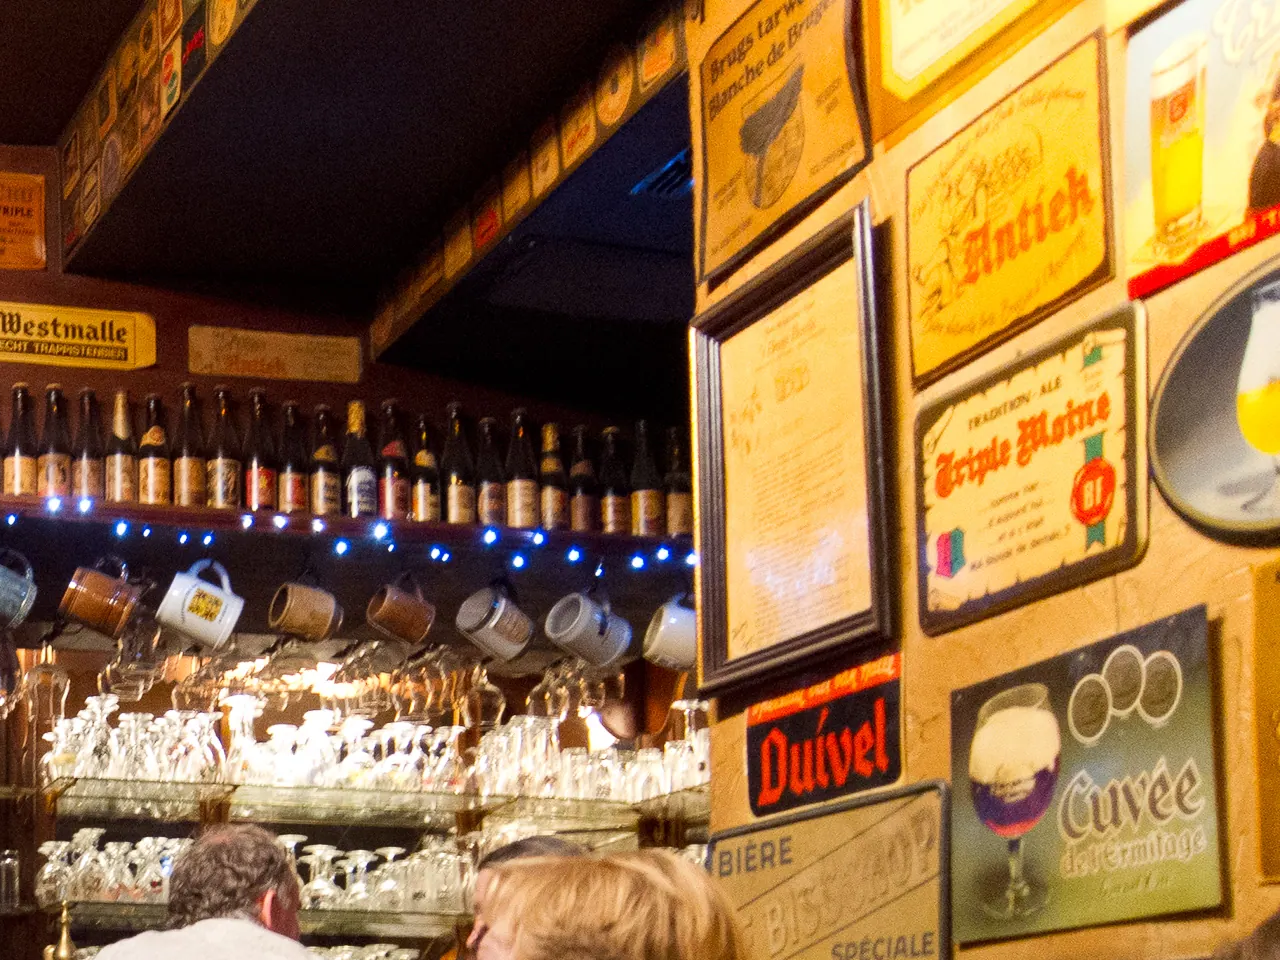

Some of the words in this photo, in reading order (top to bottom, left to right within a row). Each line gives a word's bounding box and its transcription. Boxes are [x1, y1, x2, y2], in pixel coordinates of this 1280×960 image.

[709, 60, 764, 122] Blanche
[767, 40, 785, 67] de
[710, 32, 754, 83] Brugs
[758, 0, 803, 38] tarw
[1040, 375, 1062, 396] ALE
[934, 436, 1012, 498] Triple
[1016, 390, 1111, 468] Moine
[1056, 755, 1206, 844] Cuvée
[718, 836, 793, 878] BIÈRE
